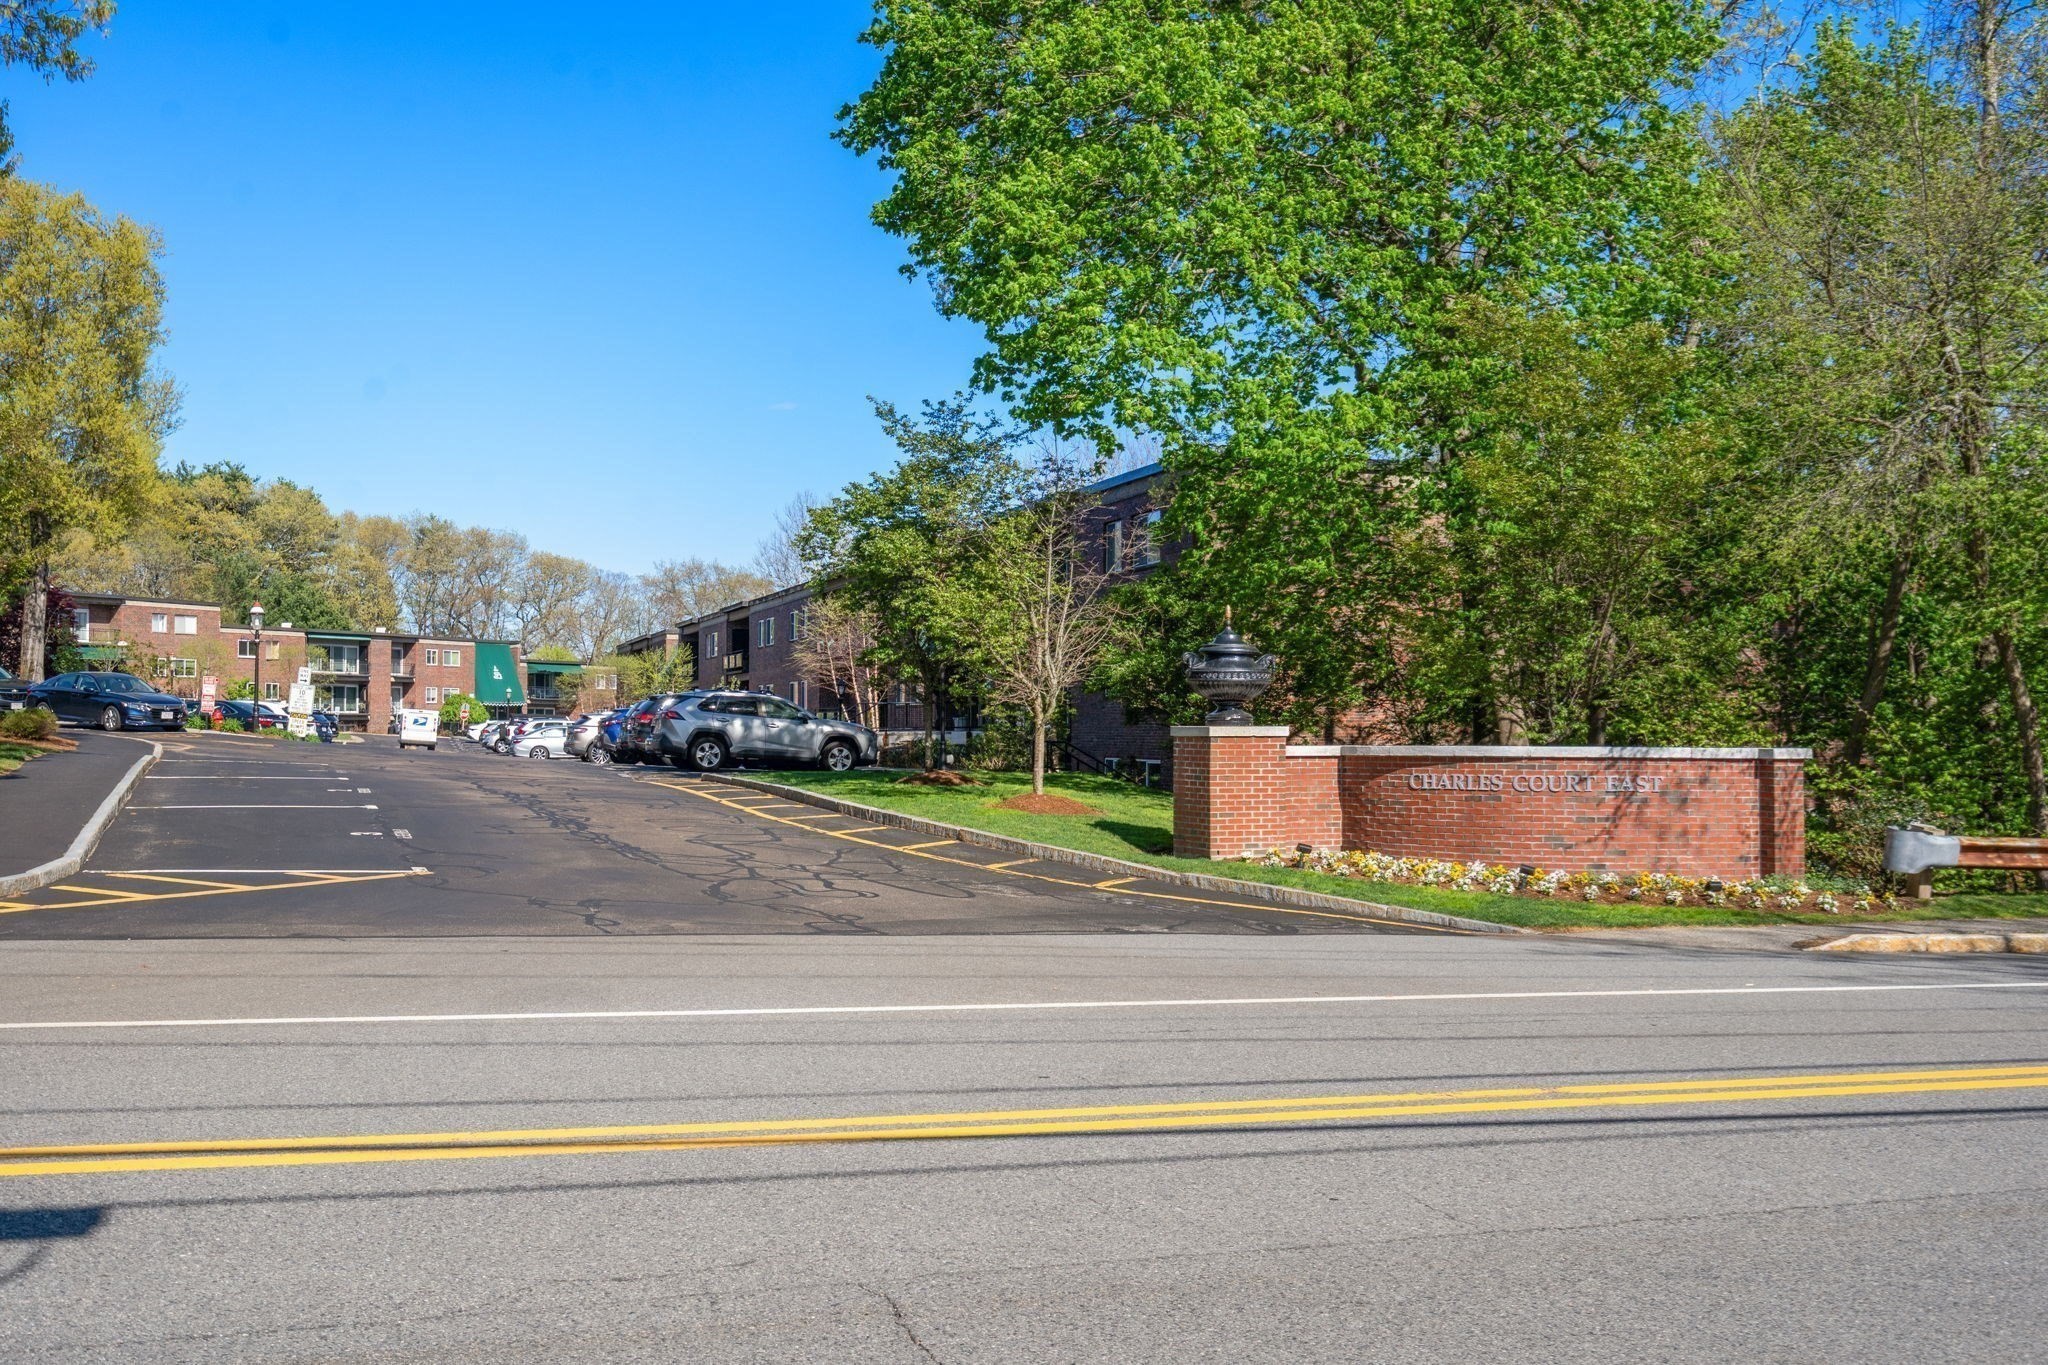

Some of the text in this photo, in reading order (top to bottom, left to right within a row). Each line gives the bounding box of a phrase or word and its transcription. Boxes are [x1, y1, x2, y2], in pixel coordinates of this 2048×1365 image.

[1408, 773, 1664, 794] CHARLES COURT EAST
